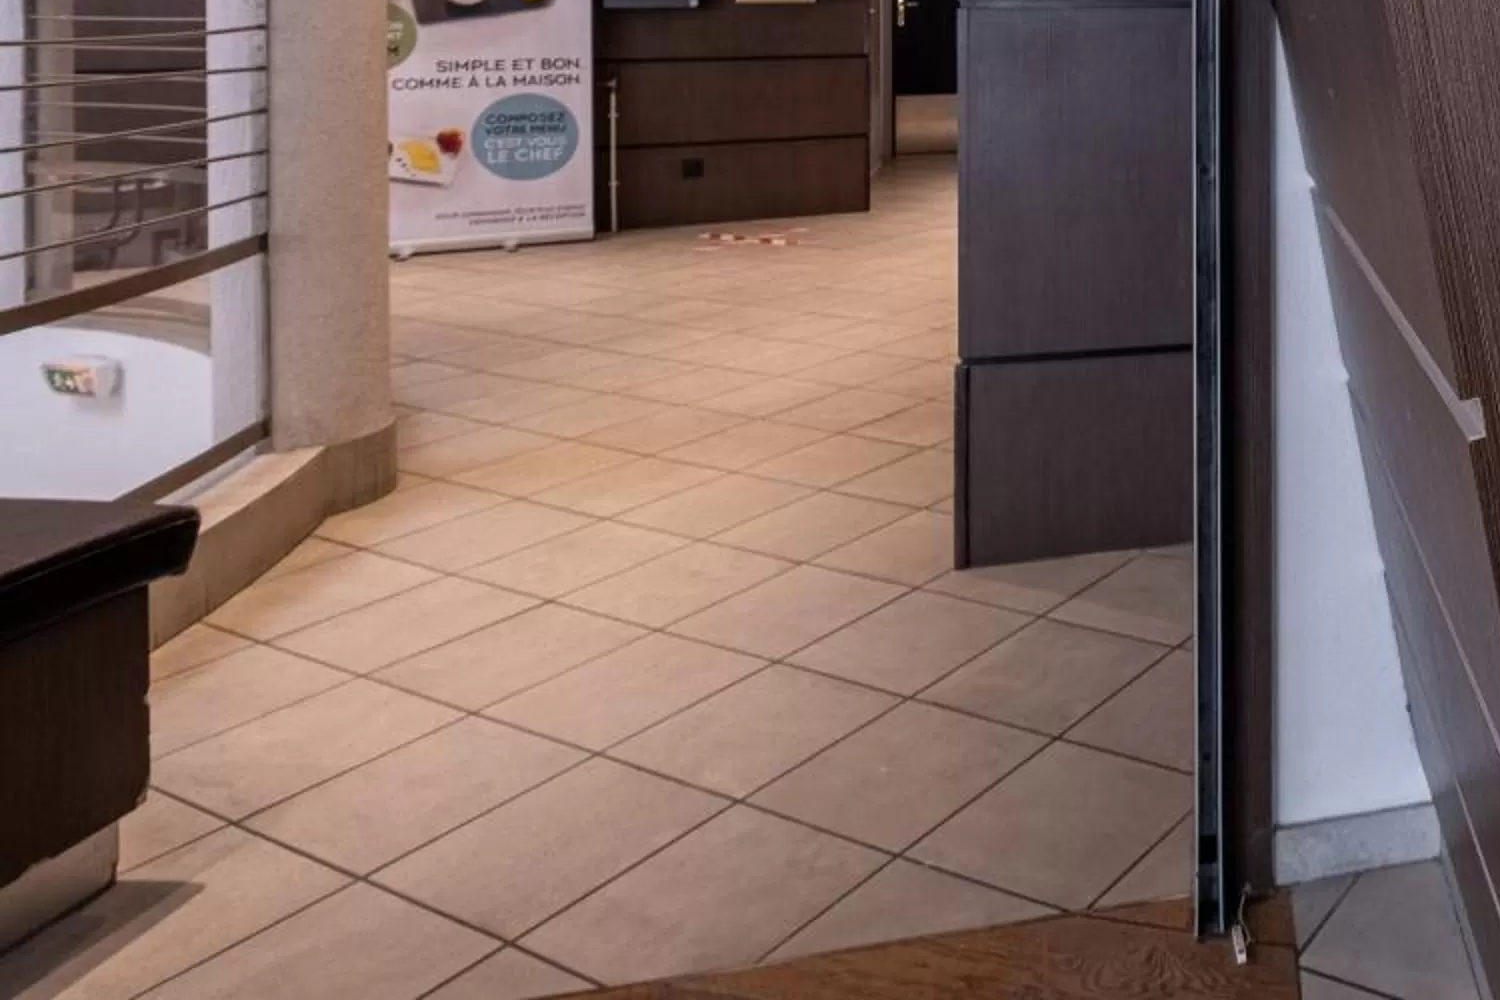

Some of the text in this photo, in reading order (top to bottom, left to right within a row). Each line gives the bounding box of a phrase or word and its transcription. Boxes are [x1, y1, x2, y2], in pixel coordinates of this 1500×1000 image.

[435, 57, 580, 73] SIMPLE ET BON
[391, 75, 462, 91] COMME
[485, 75, 507, 88] LA
[512, 72, 580, 87] MAISON
[484, 111, 565, 124] COMPOSEZ
[527, 135, 568, 147] VOUS
[487, 147, 563, 163] LE CHEF
